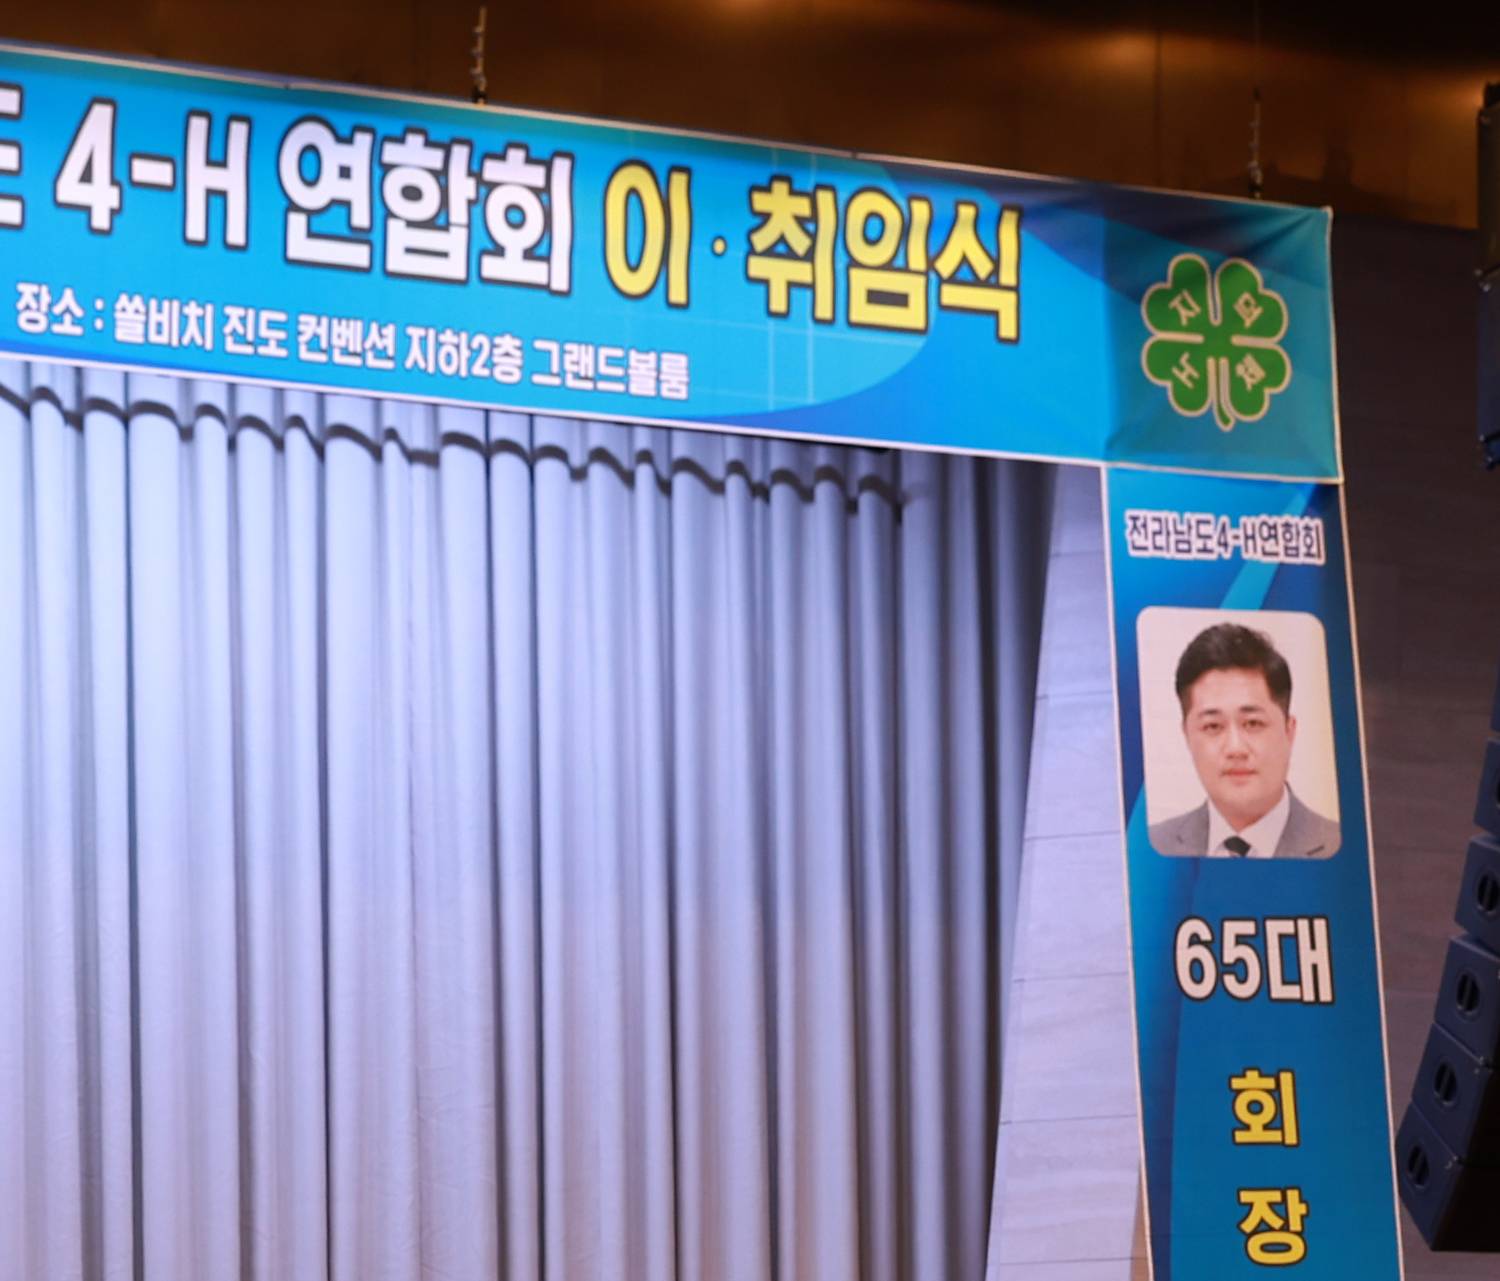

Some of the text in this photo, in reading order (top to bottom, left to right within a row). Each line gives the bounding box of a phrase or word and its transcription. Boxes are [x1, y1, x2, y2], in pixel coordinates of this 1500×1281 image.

[54, 97, 252, 251] 4-H
[277, 113, 574, 294] 연합회
[14, 282, 85, 337] 장소
[113, 291, 215, 352] 쏠비치
[222, 304, 289, 360] 진도
[296, 313, 397, 371] 컨벤션
[404, 325, 523, 385] 지하2층
[530, 338, 690, 401] 그랜드볼룸
[1126, 510, 1324, 563] 전라남도4-H연합회
[1174, 916, 1335, 1004] 65대
